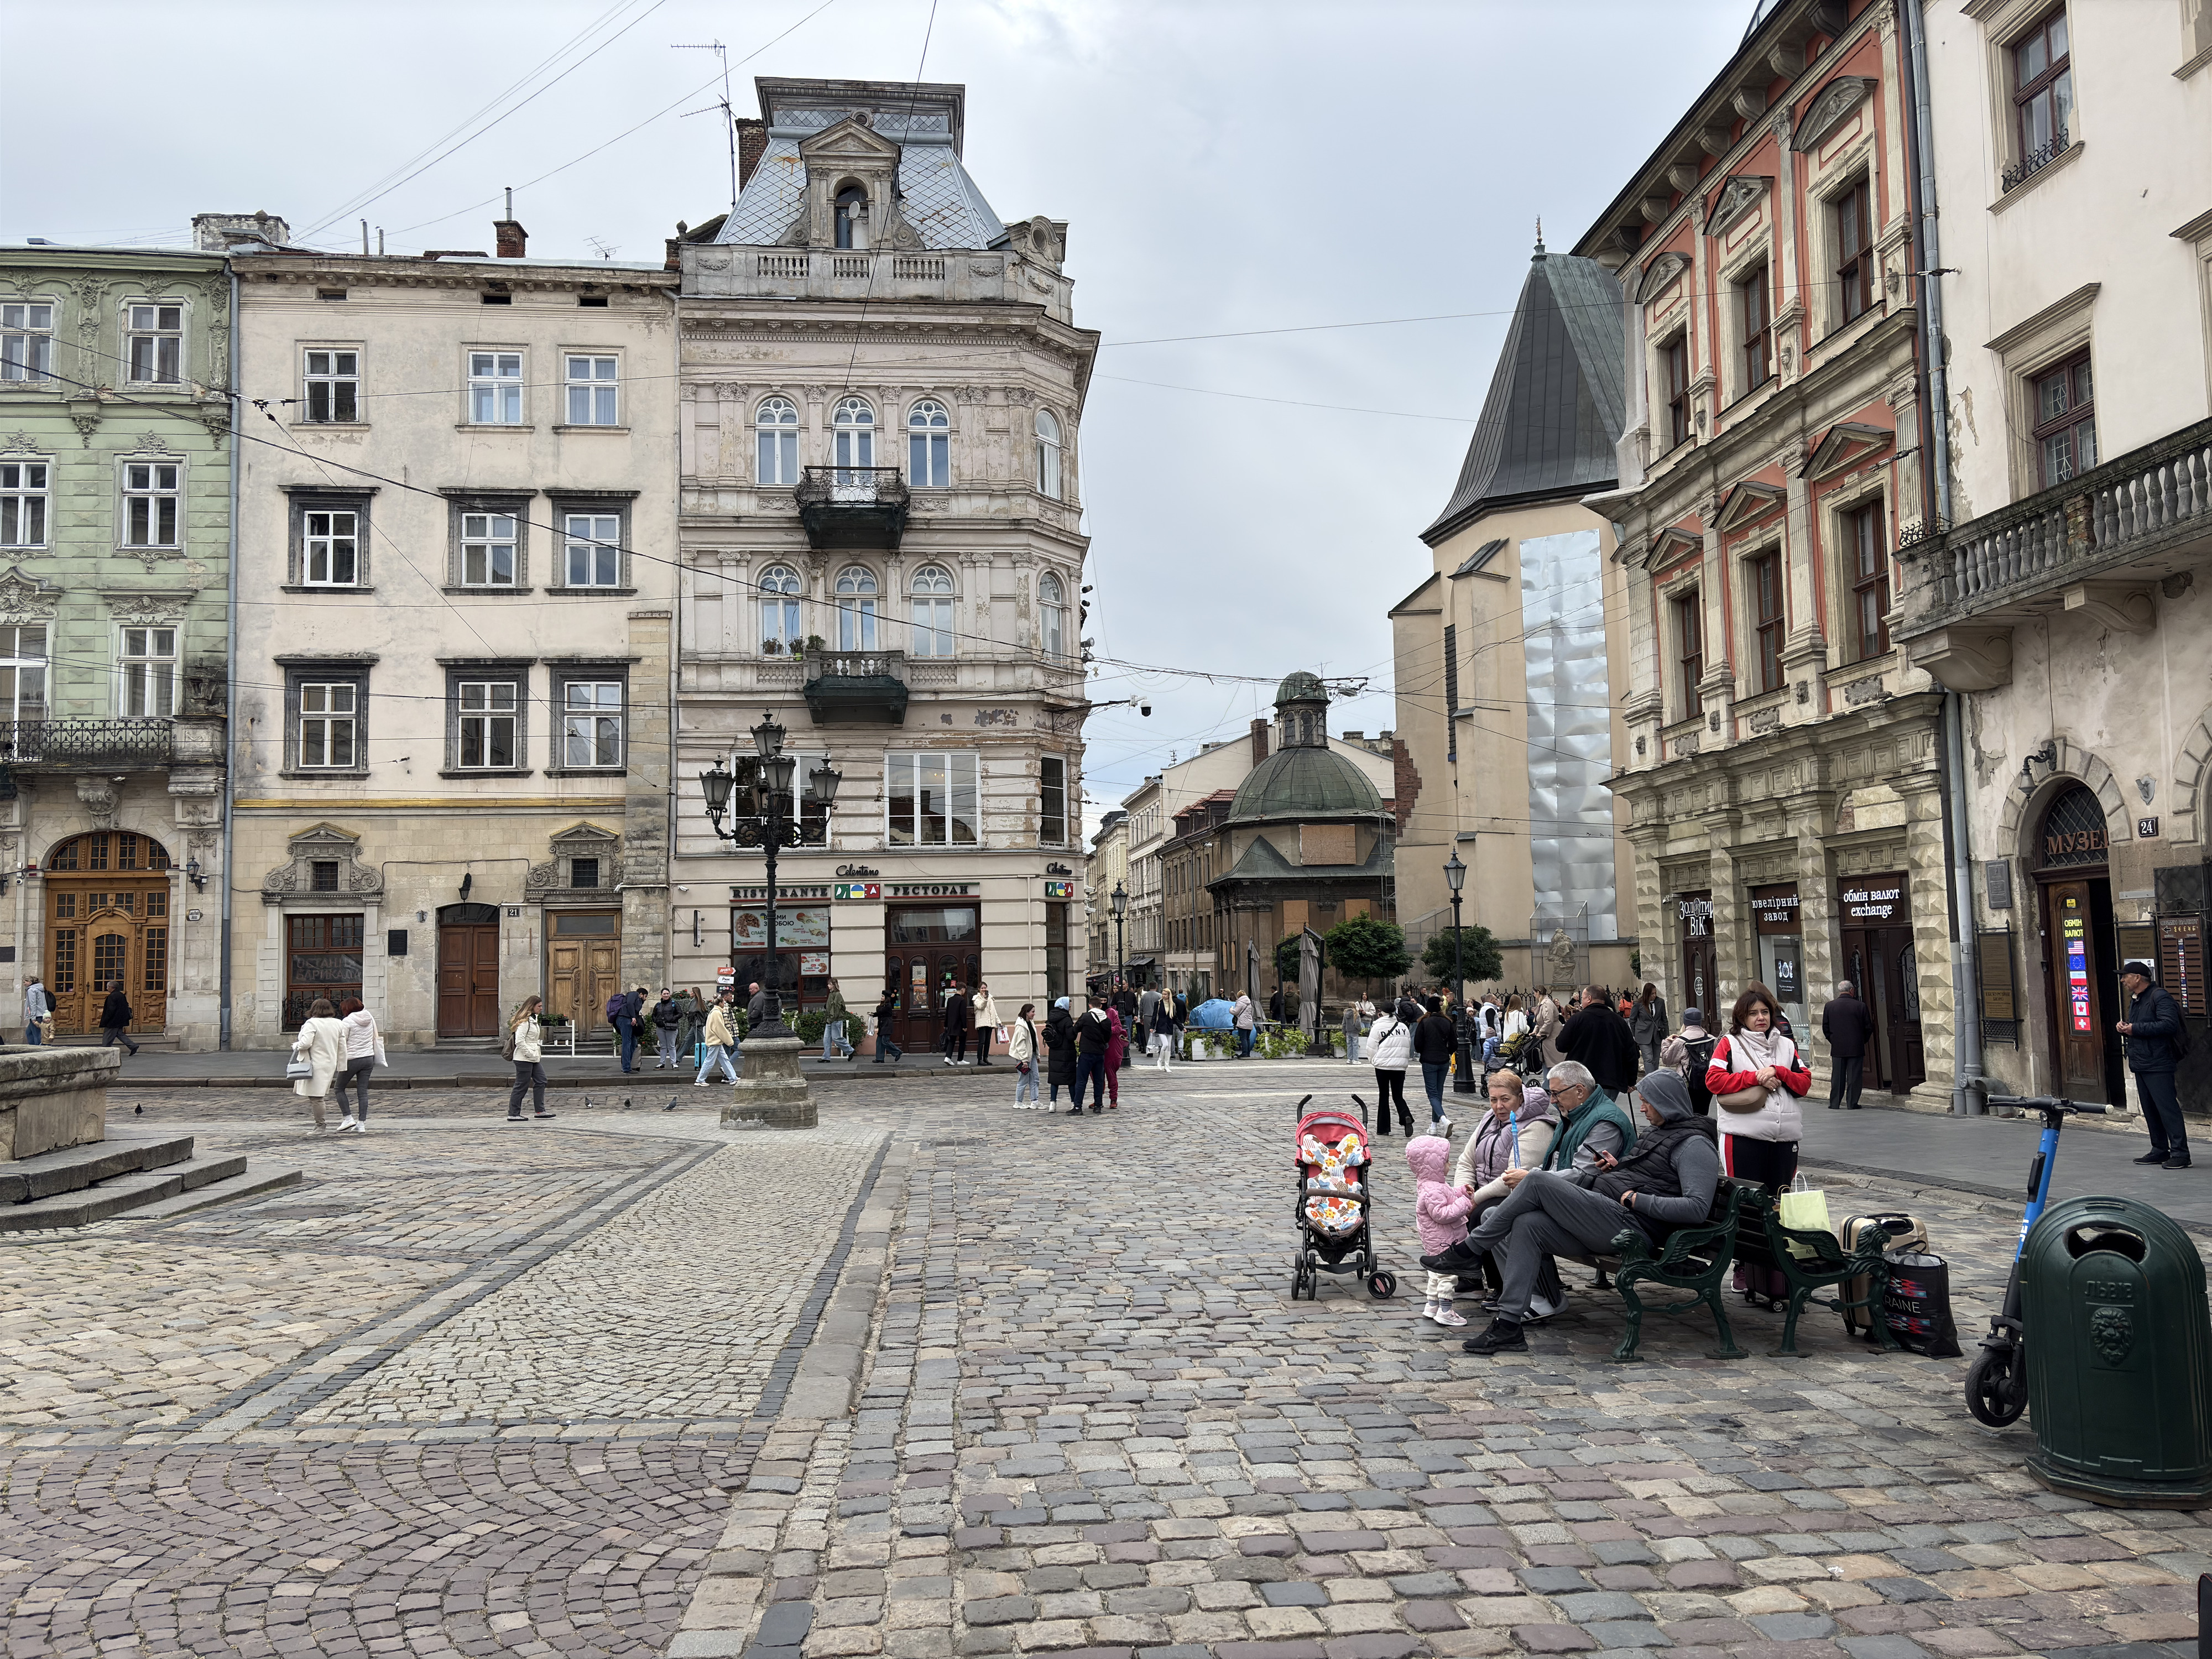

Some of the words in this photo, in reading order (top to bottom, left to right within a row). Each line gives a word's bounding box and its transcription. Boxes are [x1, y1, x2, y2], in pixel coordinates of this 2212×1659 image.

[2141, 820, 2153, 834] 24
[836, 863, 879, 877] Celentano
[733, 886, 828, 898] RISTRANTE
[894, 886, 968, 895] РЕСТОРАН
[1844, 888, 1868, 902] обмін
[1870, 889, 1900, 900] валют
[1752, 894, 1799, 910] ювелірний
[1764, 912, 1788, 922] завод
[1851, 902, 1892, 919] exchange
[2065, 929, 2084, 937] ВАЛЮТ
